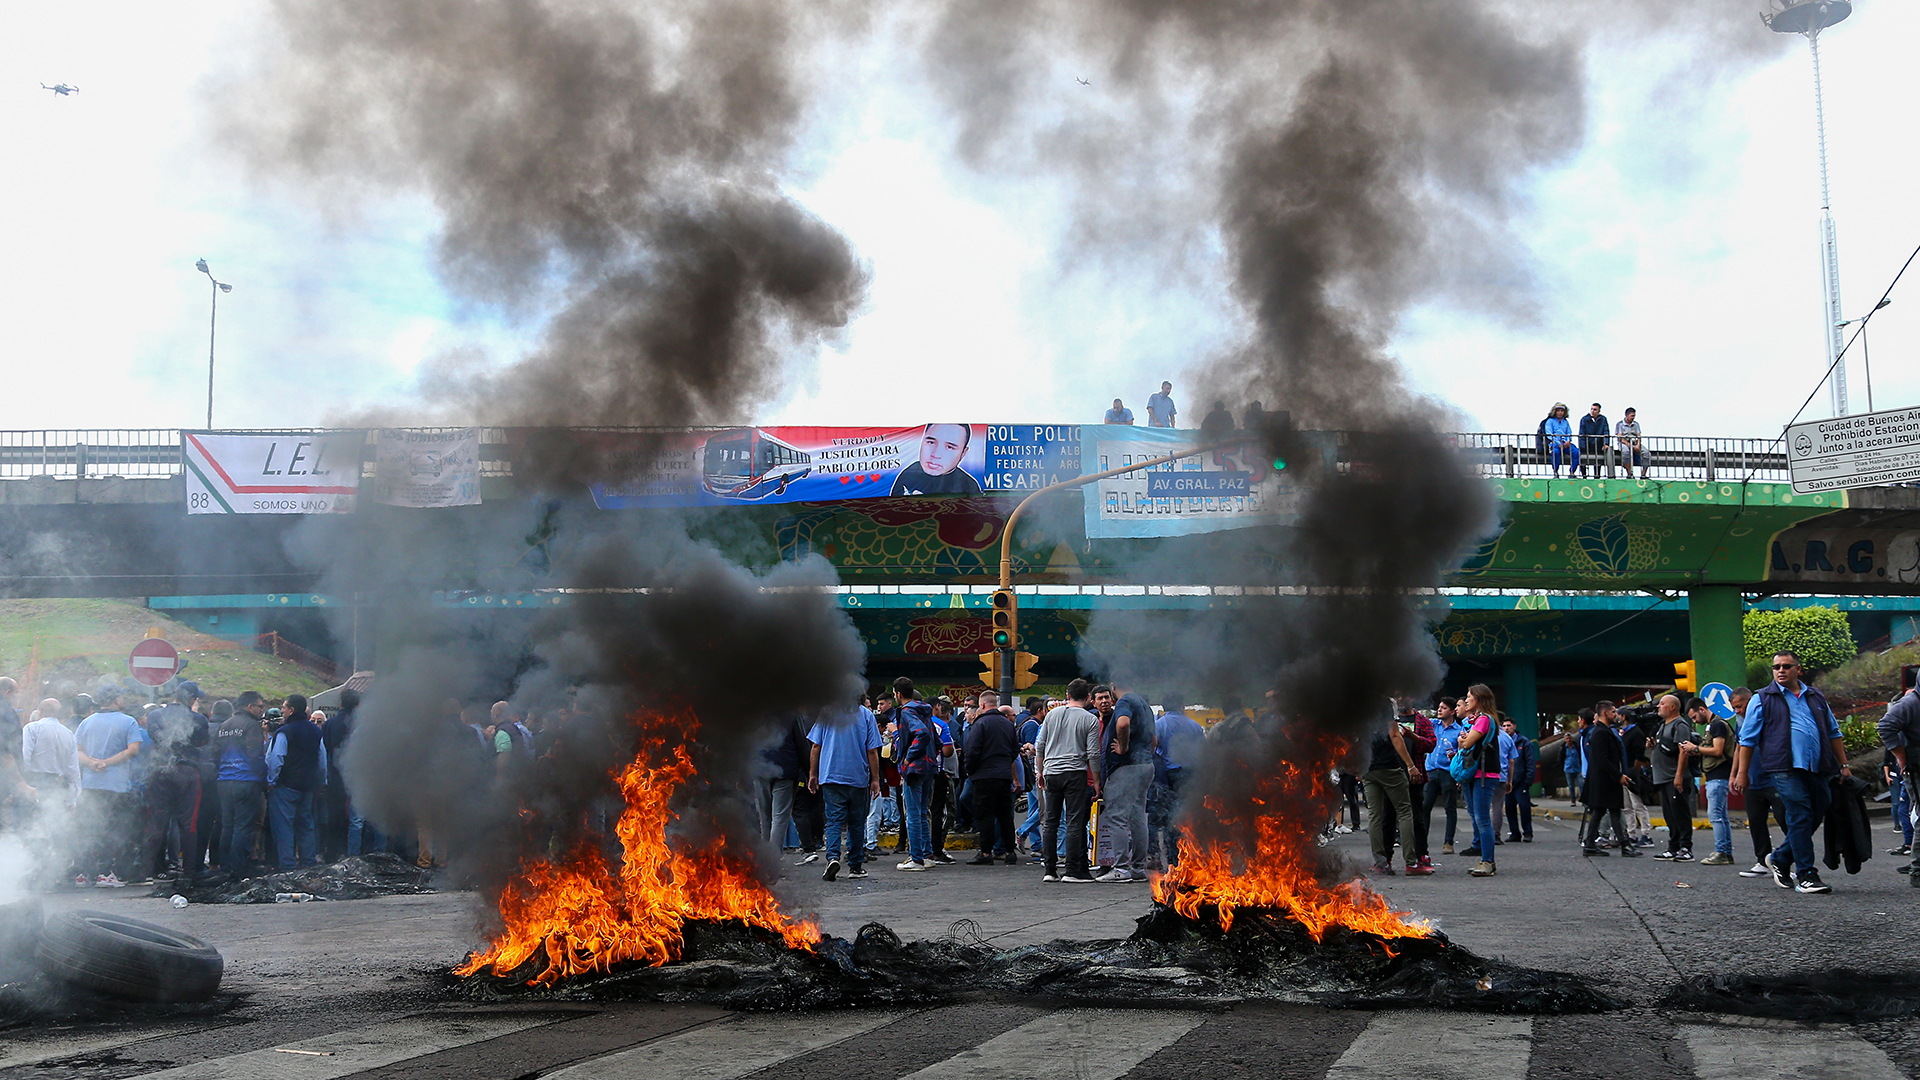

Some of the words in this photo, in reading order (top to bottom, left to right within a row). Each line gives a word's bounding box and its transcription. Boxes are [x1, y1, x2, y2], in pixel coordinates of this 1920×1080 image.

[1818, 421, 1852, 433] Ciudad
[1854, 419, 1866, 428] de
[1868, 413, 1905, 426] Buenos
[406, 431, 456, 444] JUNIORS
[832, 436, 877, 446] VERDAD
[879, 434, 887, 442] Y
[987, 426, 1019, 442] ROL
[1823, 429, 1872, 443] Prohibido
[818, 449, 869, 460] JUSTICIA
[871, 445, 899, 457] PARA
[993, 445, 1045, 456] BAUTISTA
[1060, 445, 1081, 456] ALB
[1817, 443, 1845, 455] Junto
[1846, 442, 1853, 450] a
[1855, 439, 1864, 448] la
[1866, 437, 1893, 448] acera
[818, 463, 855, 474] PABLO
[857, 459, 901, 473] FLORES
[996, 459, 1045, 469] FEDERAL
[983, 473, 1060, 489] MISARIA
[1153, 478, 1173, 491] AV.
[1175, 478, 1215, 491] GRAL.
[1219, 478, 1245, 491] PAZ
[1808, 481, 1834, 490] Salvo
[190, 492, 209, 508] 88
[253, 500, 298, 510] SOMOS
[300, 500, 328, 510] UNO
